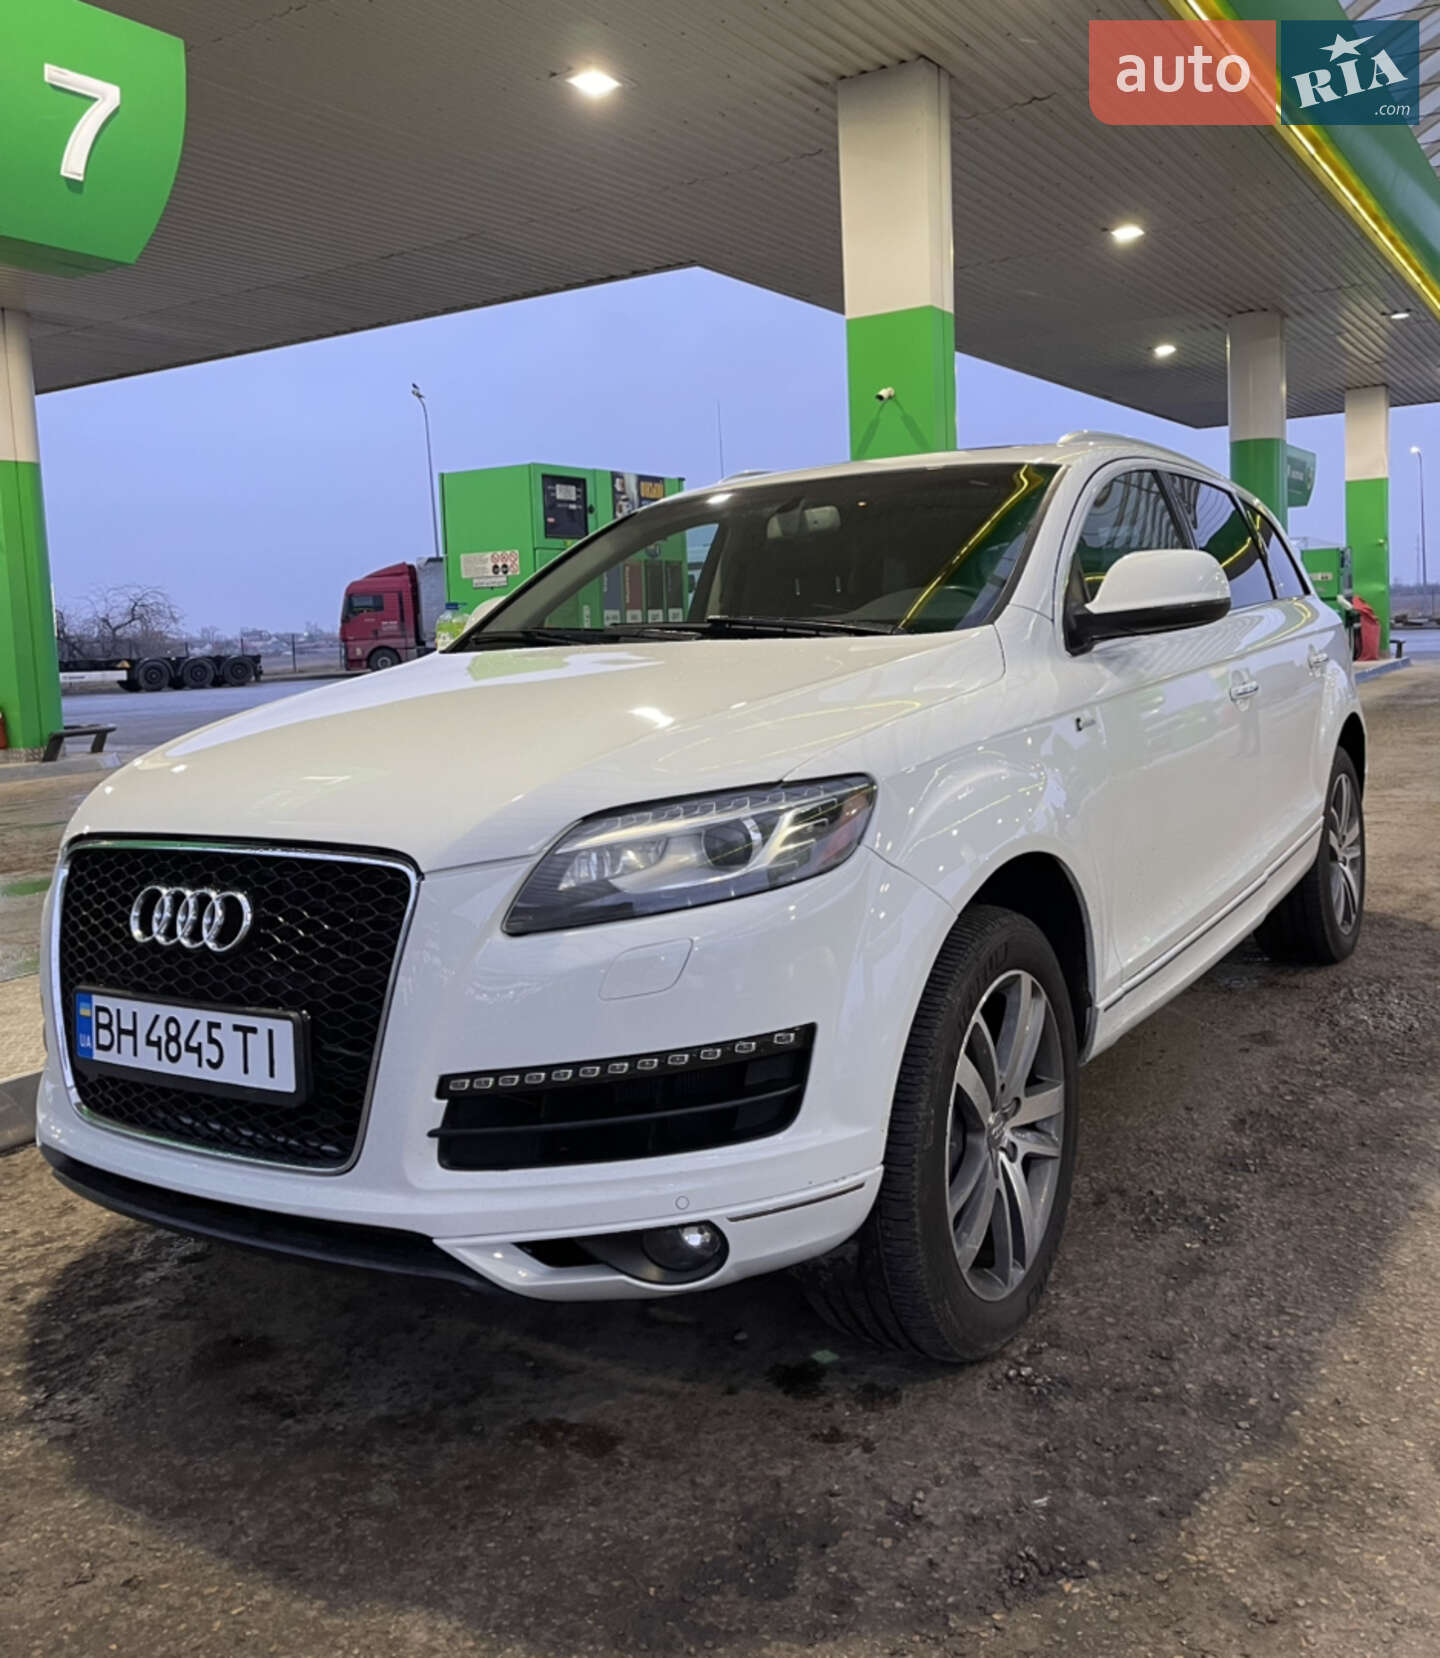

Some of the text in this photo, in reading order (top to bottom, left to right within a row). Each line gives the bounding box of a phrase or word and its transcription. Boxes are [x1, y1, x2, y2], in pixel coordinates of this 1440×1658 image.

[44, 62, 121, 181] 7
[79, 1033, 92, 1049] UA
[94, 1005, 275, 1079] BH 4845 TI
